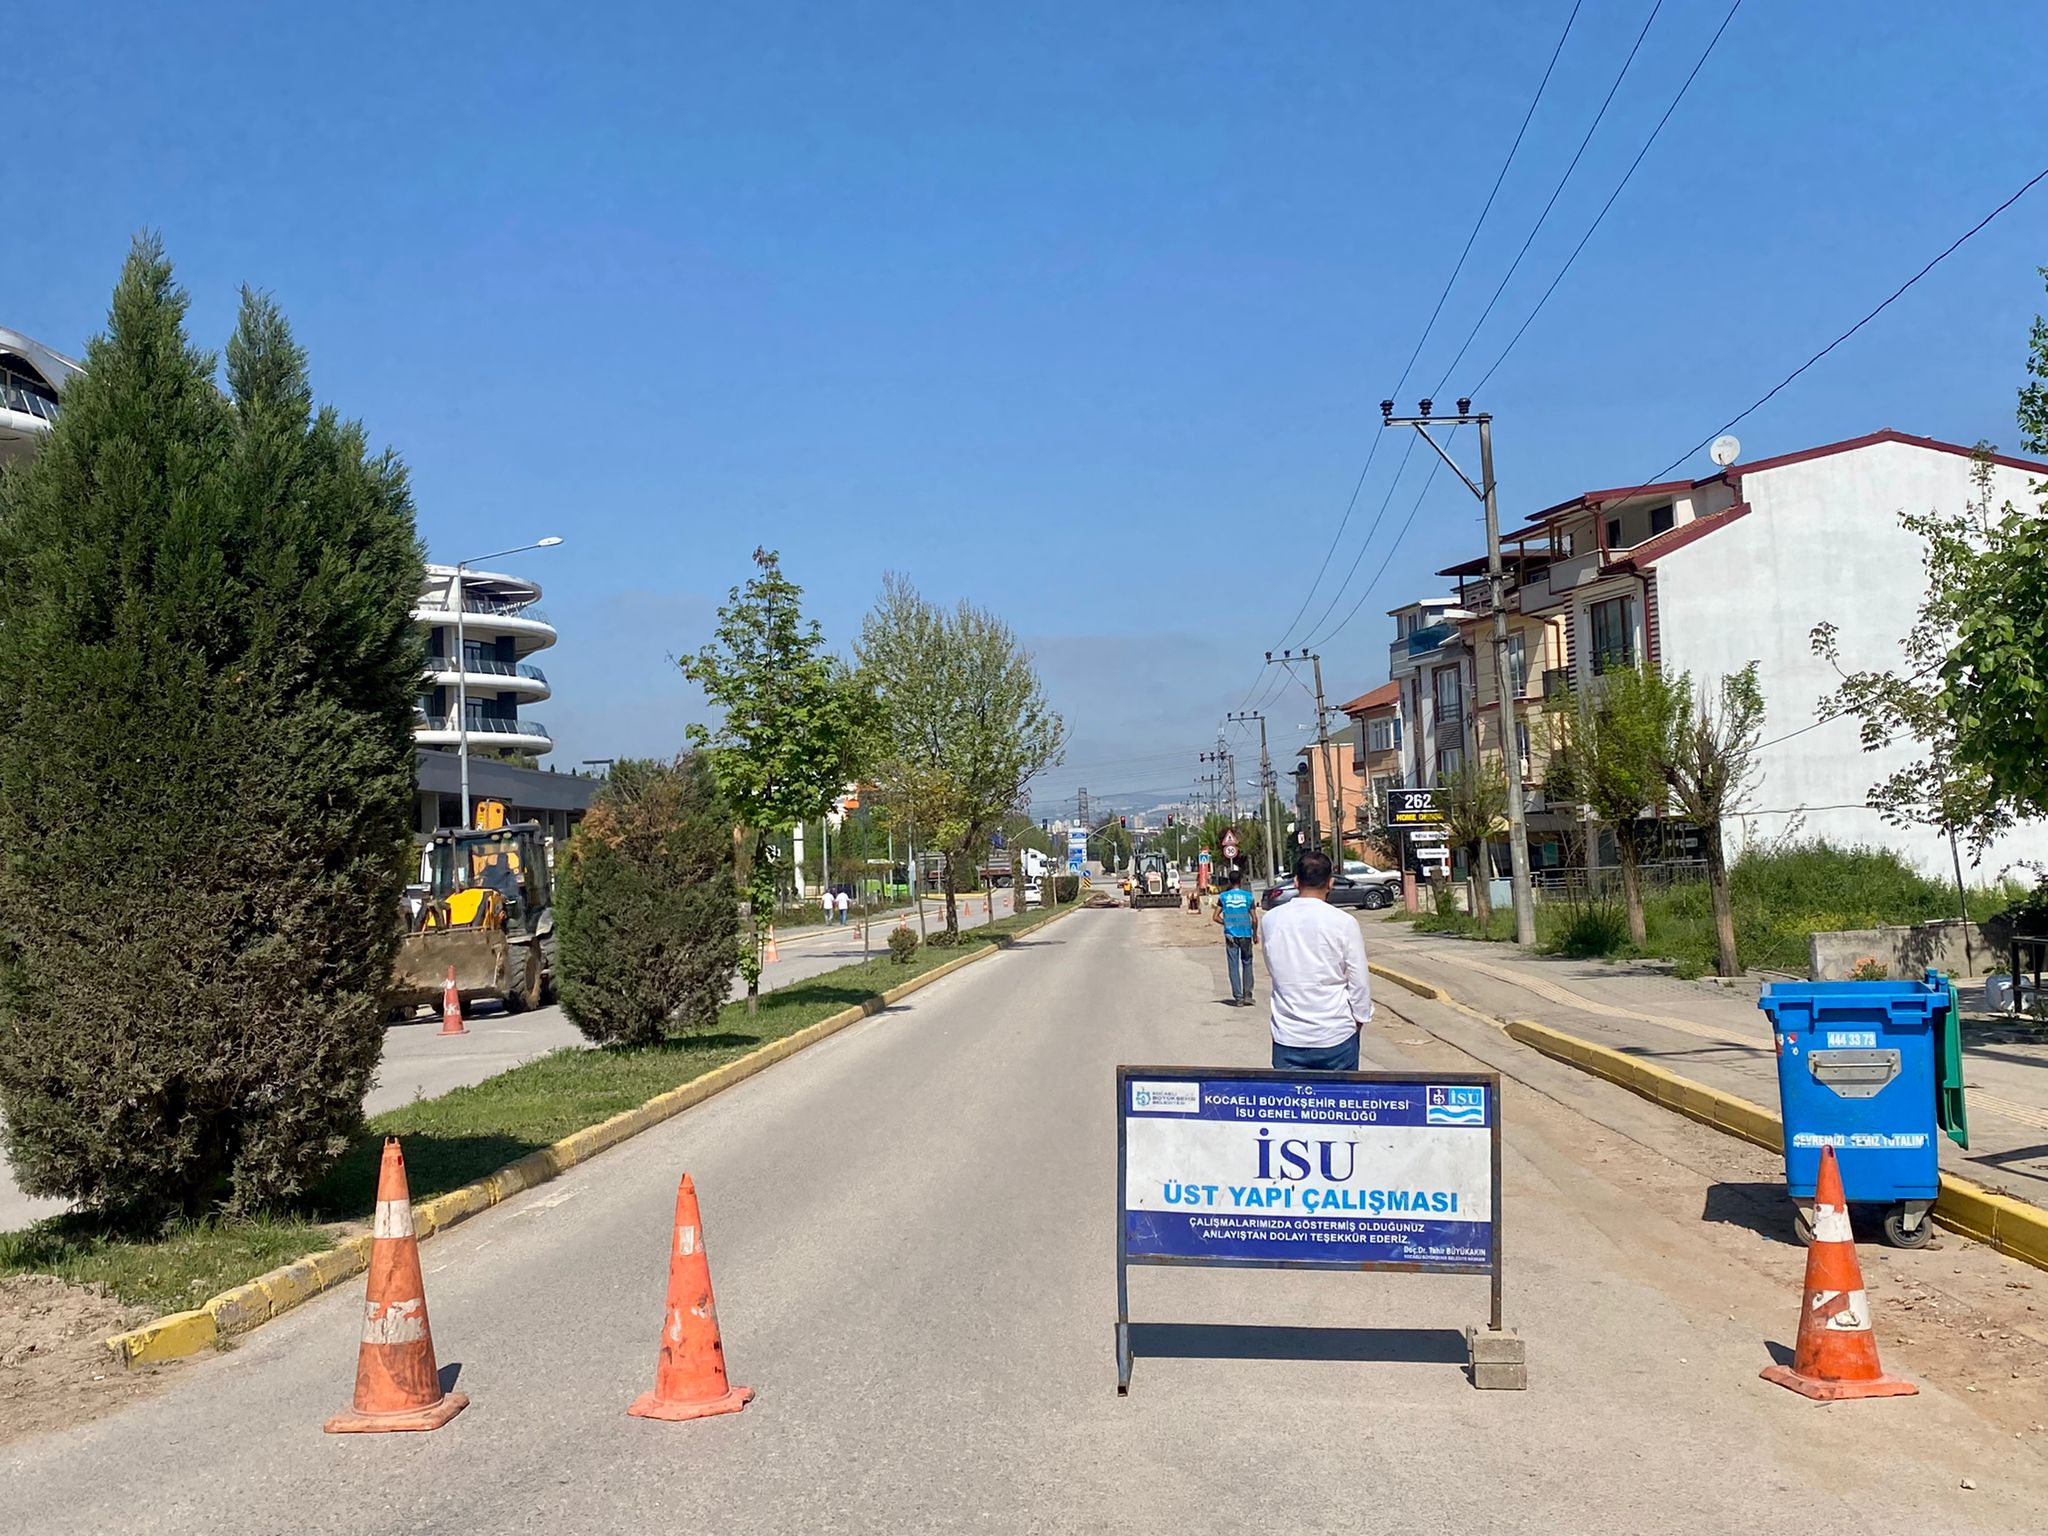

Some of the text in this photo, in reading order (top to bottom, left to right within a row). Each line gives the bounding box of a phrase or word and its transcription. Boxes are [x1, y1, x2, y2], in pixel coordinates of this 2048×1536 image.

[1396, 813, 1417, 821] HOME
[1829, 1033, 1876, 1046] 444 33 73
[1295, 1086, 1316, 1096] T.C.
[1451, 1087, 1480, 1105] İSU
[1204, 1094, 1409, 1110] KOCAELİ BÜYÜKŞEHİR BELEDİYESİ
[1236, 1107, 1377, 1121] İSU GENEL MÜDÜRLÜĞÜ
[1253, 1128, 1360, 1182] İSU
[1164, 1179, 1458, 1215] ÜST YAPI ÇALIŞMASI
[1189, 1217, 1425, 1233] ÇALIŞMALARIMIZDA GÖSTERMİŞ OLDUĞUNUZ
[1202, 1230, 1411, 1244] ANLAYIŞTAN DOLAYI TEŞEKKÜR EDERİZ.
[1428, 1246, 1445, 1254] Tahir
[1446, 1246, 1486, 1256] BÜYÜKAKIN
